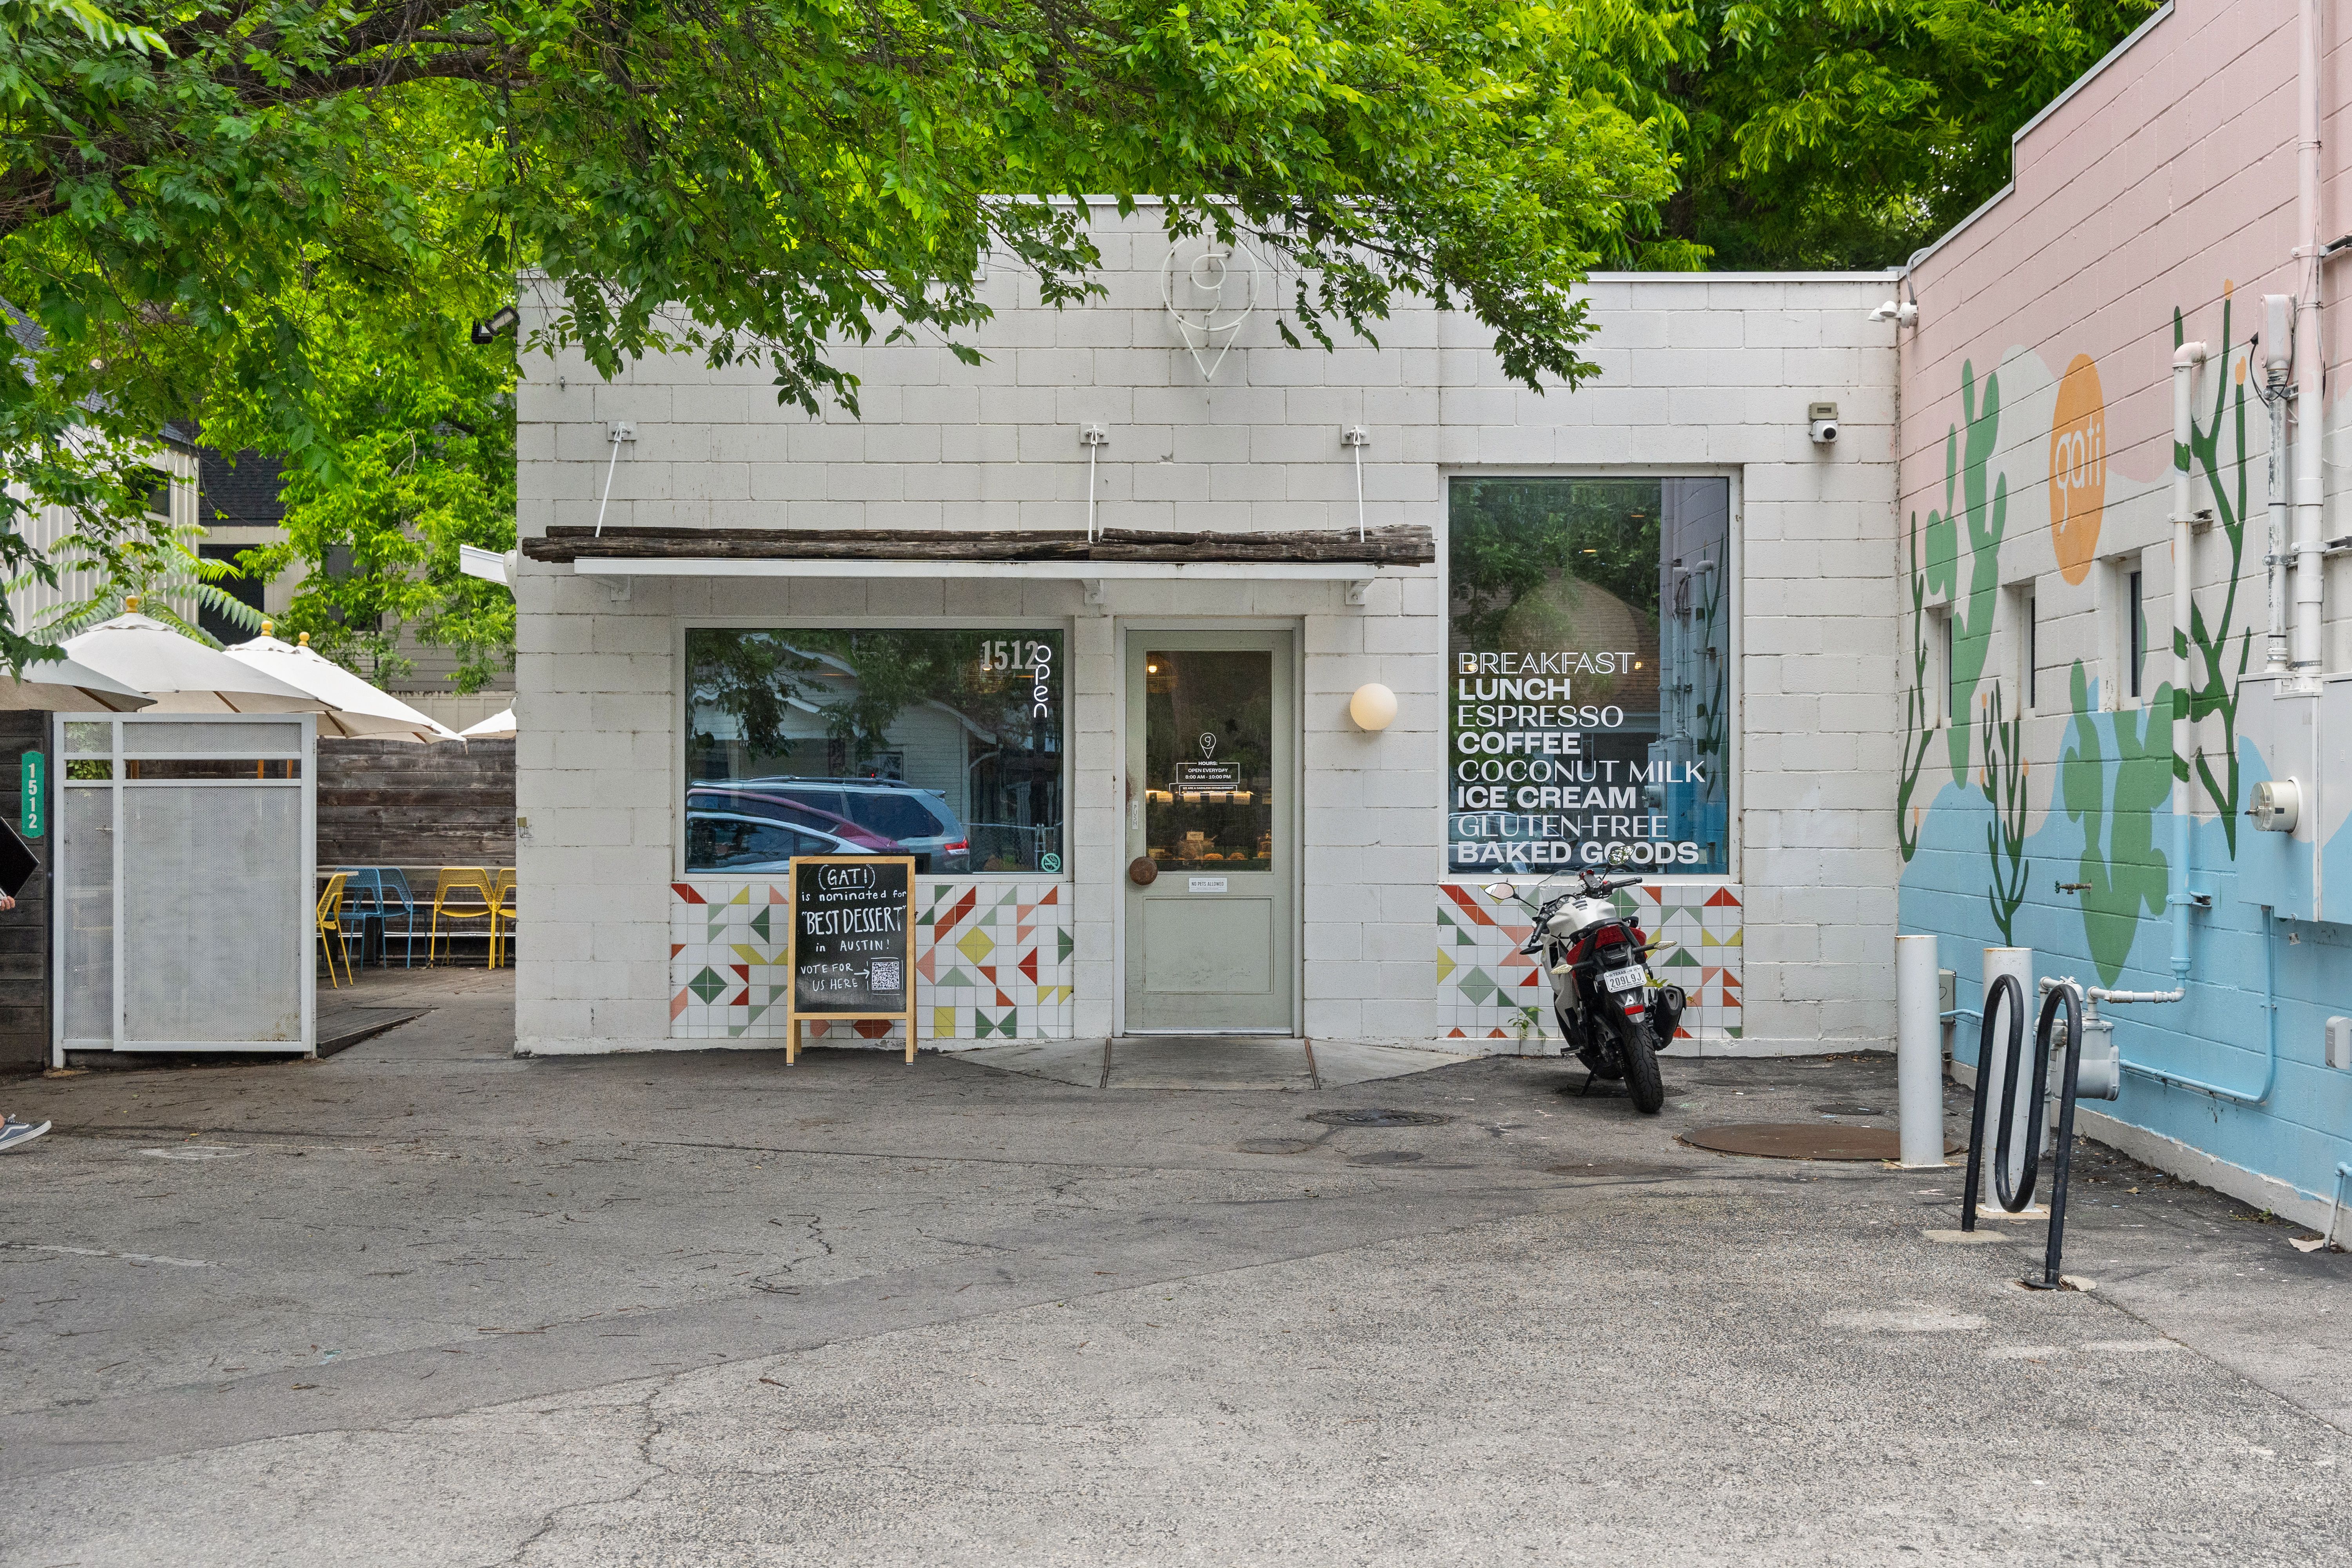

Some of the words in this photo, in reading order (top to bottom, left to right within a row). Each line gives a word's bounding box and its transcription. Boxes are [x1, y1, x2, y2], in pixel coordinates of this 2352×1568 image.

[2055, 414, 2101, 534] gati
[982, 640, 1038, 670] 1512
[1458, 652, 1635, 674] BREAKFAST
[1458, 678, 1570, 701] LUNCH
[1457, 705, 1623, 728] ESPRESSO
[1457, 731, 1581, 755] COFFEE
[1458, 760, 1620, 782] COCONUT
[1629, 760, 1706, 783] MILK
[29, 763, 37, 828] 1512
[1458, 786, 1508, 808] ICE
[1516, 786, 1636, 809] CREAM
[1457, 815, 1668, 838] GLUTEN-FREE
[1458, 841, 1572, 863] BAKED
[802, 892, 810, 902] is
[819, 890, 886, 902] nominated
[893, 890, 907, 898] for
[816, 943, 826, 952] in
[840, 939, 890, 951] AUSTIN!
[800, 964, 828, 974] VOTE
[832, 963, 853, 972] FOR
[1610, 973, 1641, 987] 209L9J
[813, 979, 824, 991] US
[830, 978, 858, 989] HERE
